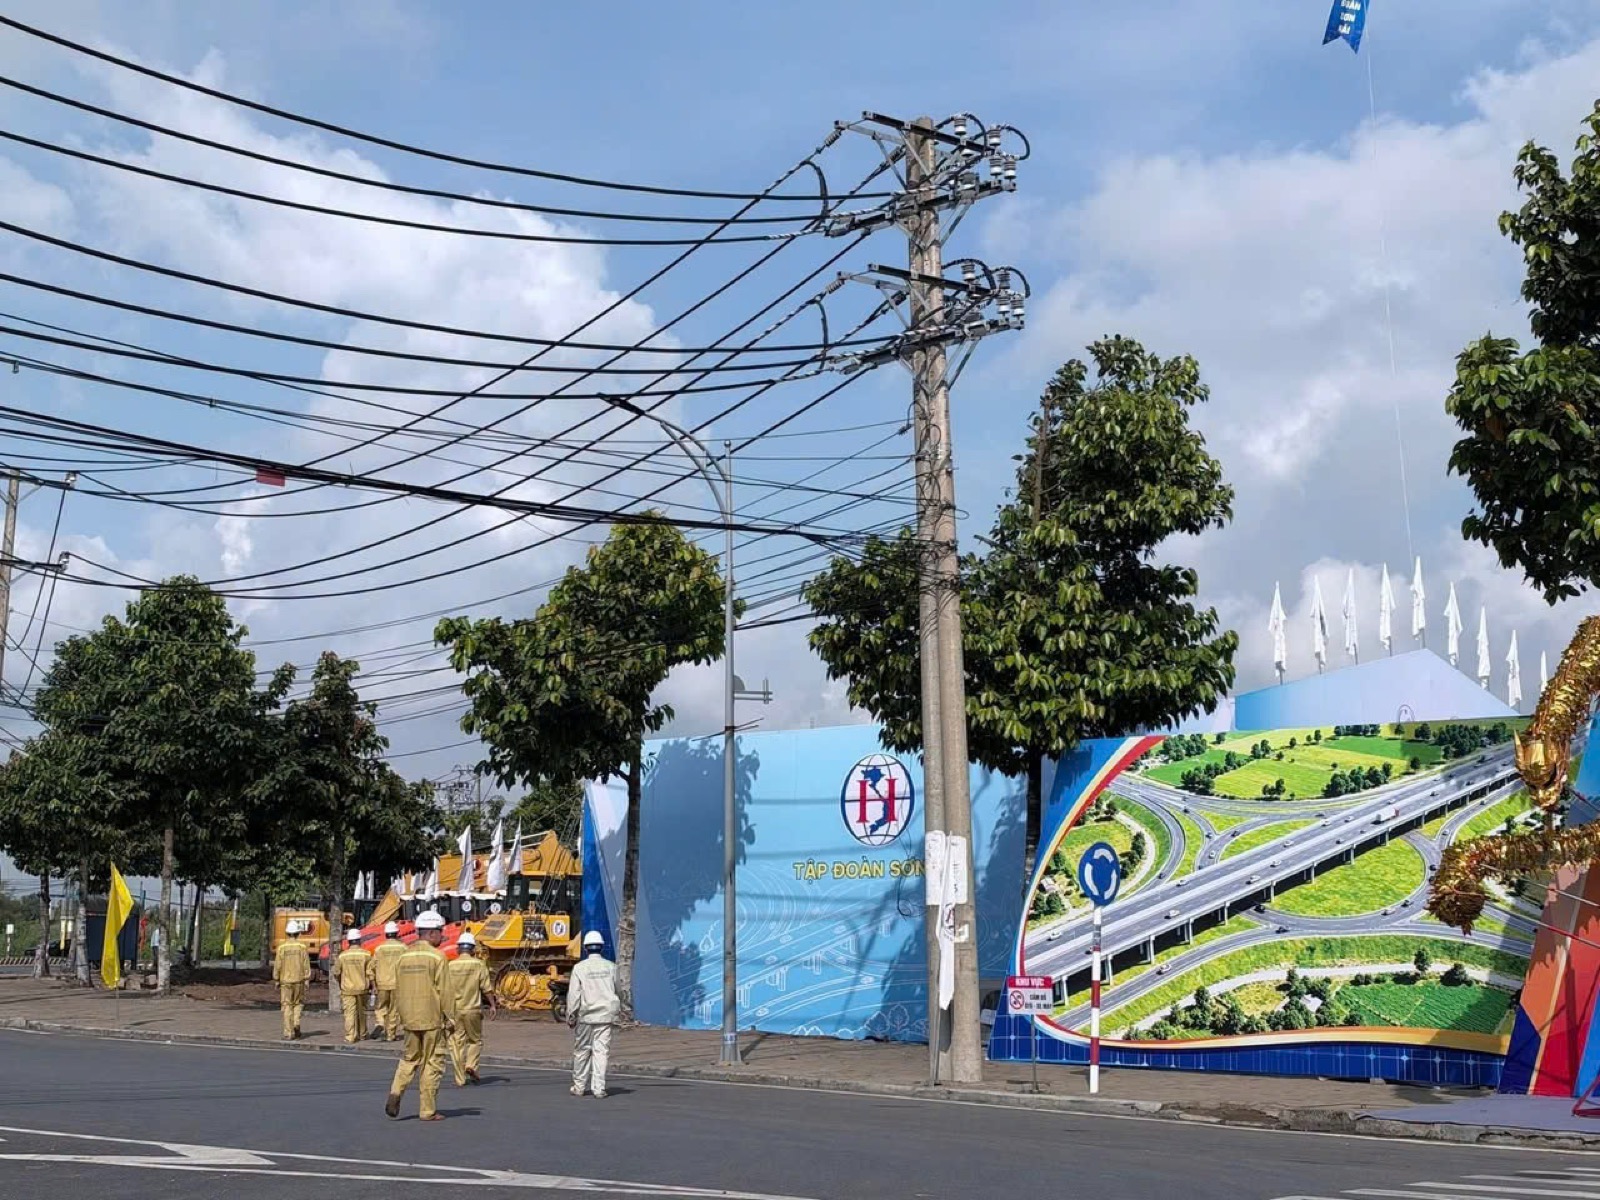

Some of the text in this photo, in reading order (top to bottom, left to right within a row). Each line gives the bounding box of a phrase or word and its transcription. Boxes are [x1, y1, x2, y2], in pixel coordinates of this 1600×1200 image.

[793, 858, 828, 885] TẬP
[832, 855, 885, 879] ĐOÀN
[1015, 978, 1045, 988] KHU VỰC
